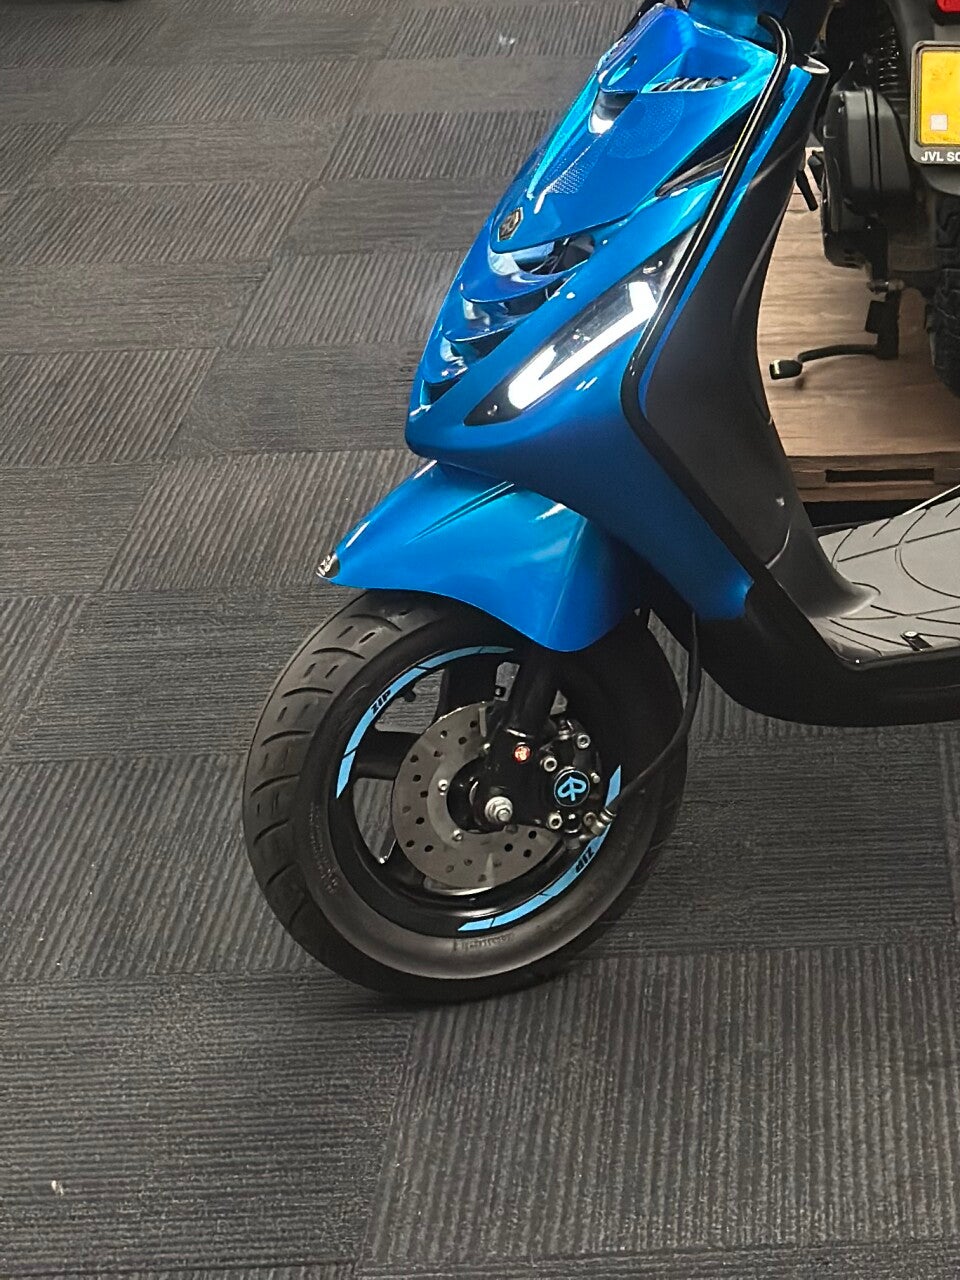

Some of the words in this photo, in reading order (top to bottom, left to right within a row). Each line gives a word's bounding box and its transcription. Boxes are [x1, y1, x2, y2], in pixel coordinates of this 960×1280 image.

[920, 151, 944, 162] JVL
[372, 689, 391, 714] ZIP
[575, 846, 594, 873] ZIP
